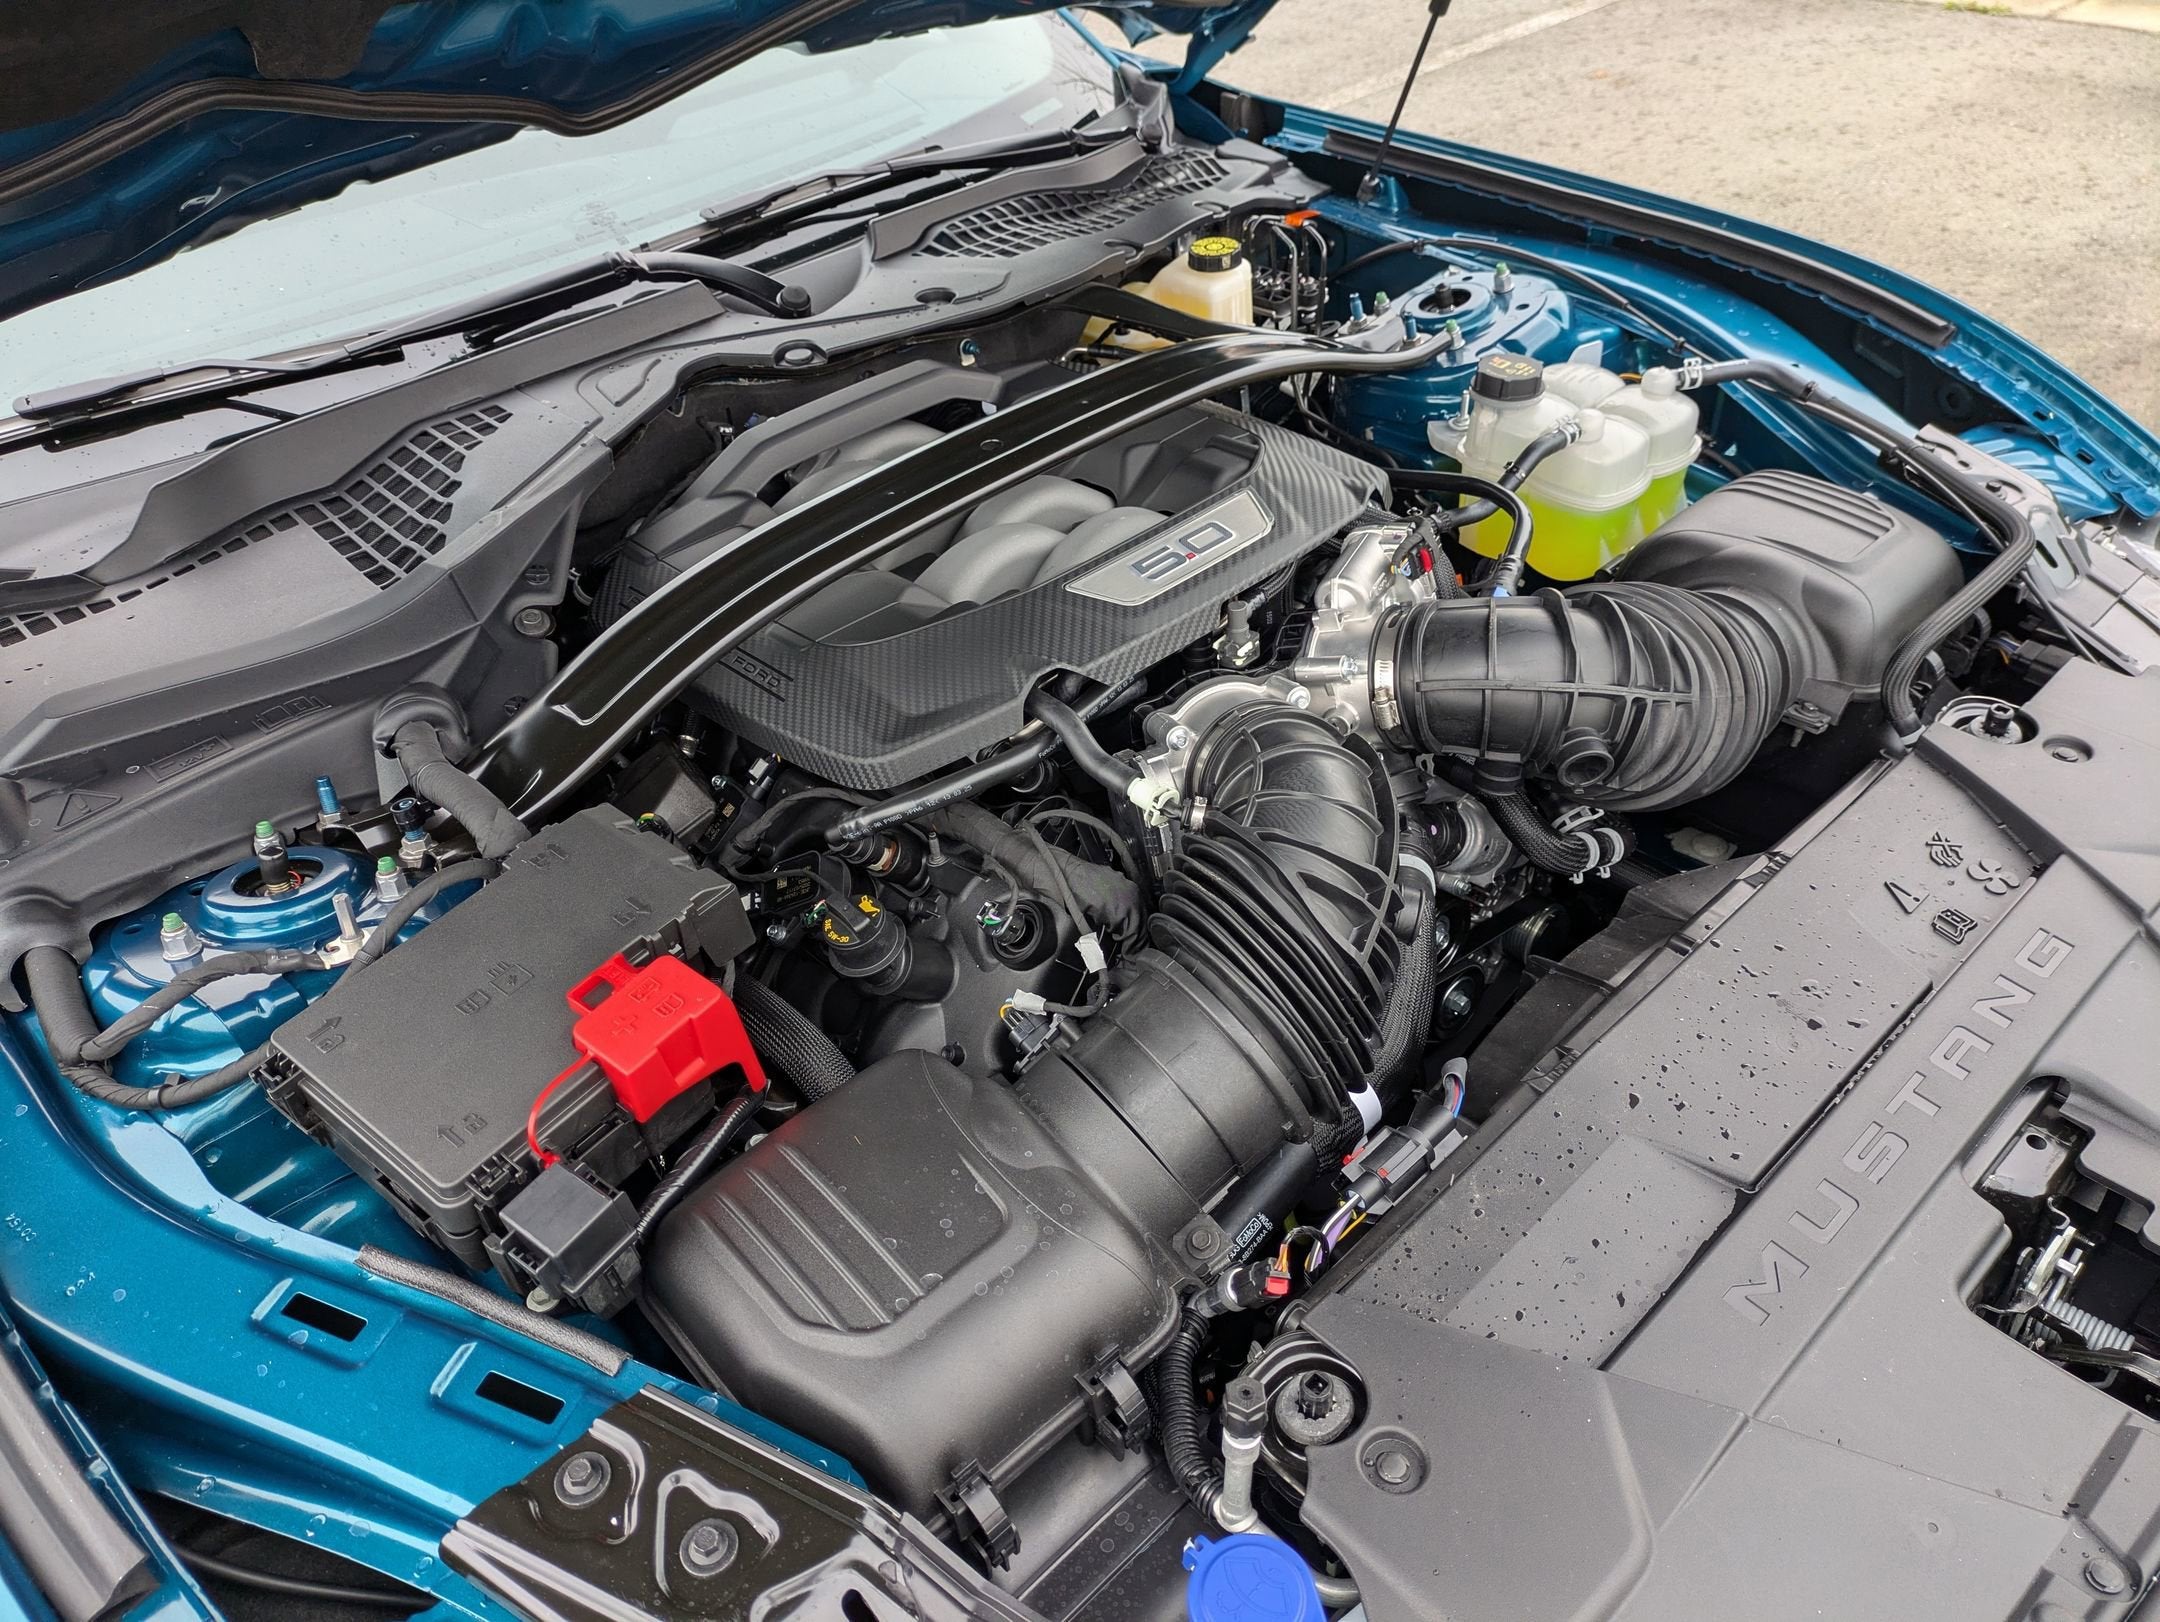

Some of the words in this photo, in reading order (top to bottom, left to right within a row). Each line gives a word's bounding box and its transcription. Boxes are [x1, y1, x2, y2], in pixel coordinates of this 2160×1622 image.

[1130, 521, 1236, 581] 5.0
[730, 655, 781, 688] FORD
[828, 931, 850, 944] 5W-30
[1721, 927, 2076, 1327] MUSTANG
[1238, 1220, 1261, 1246] FoMoCo
